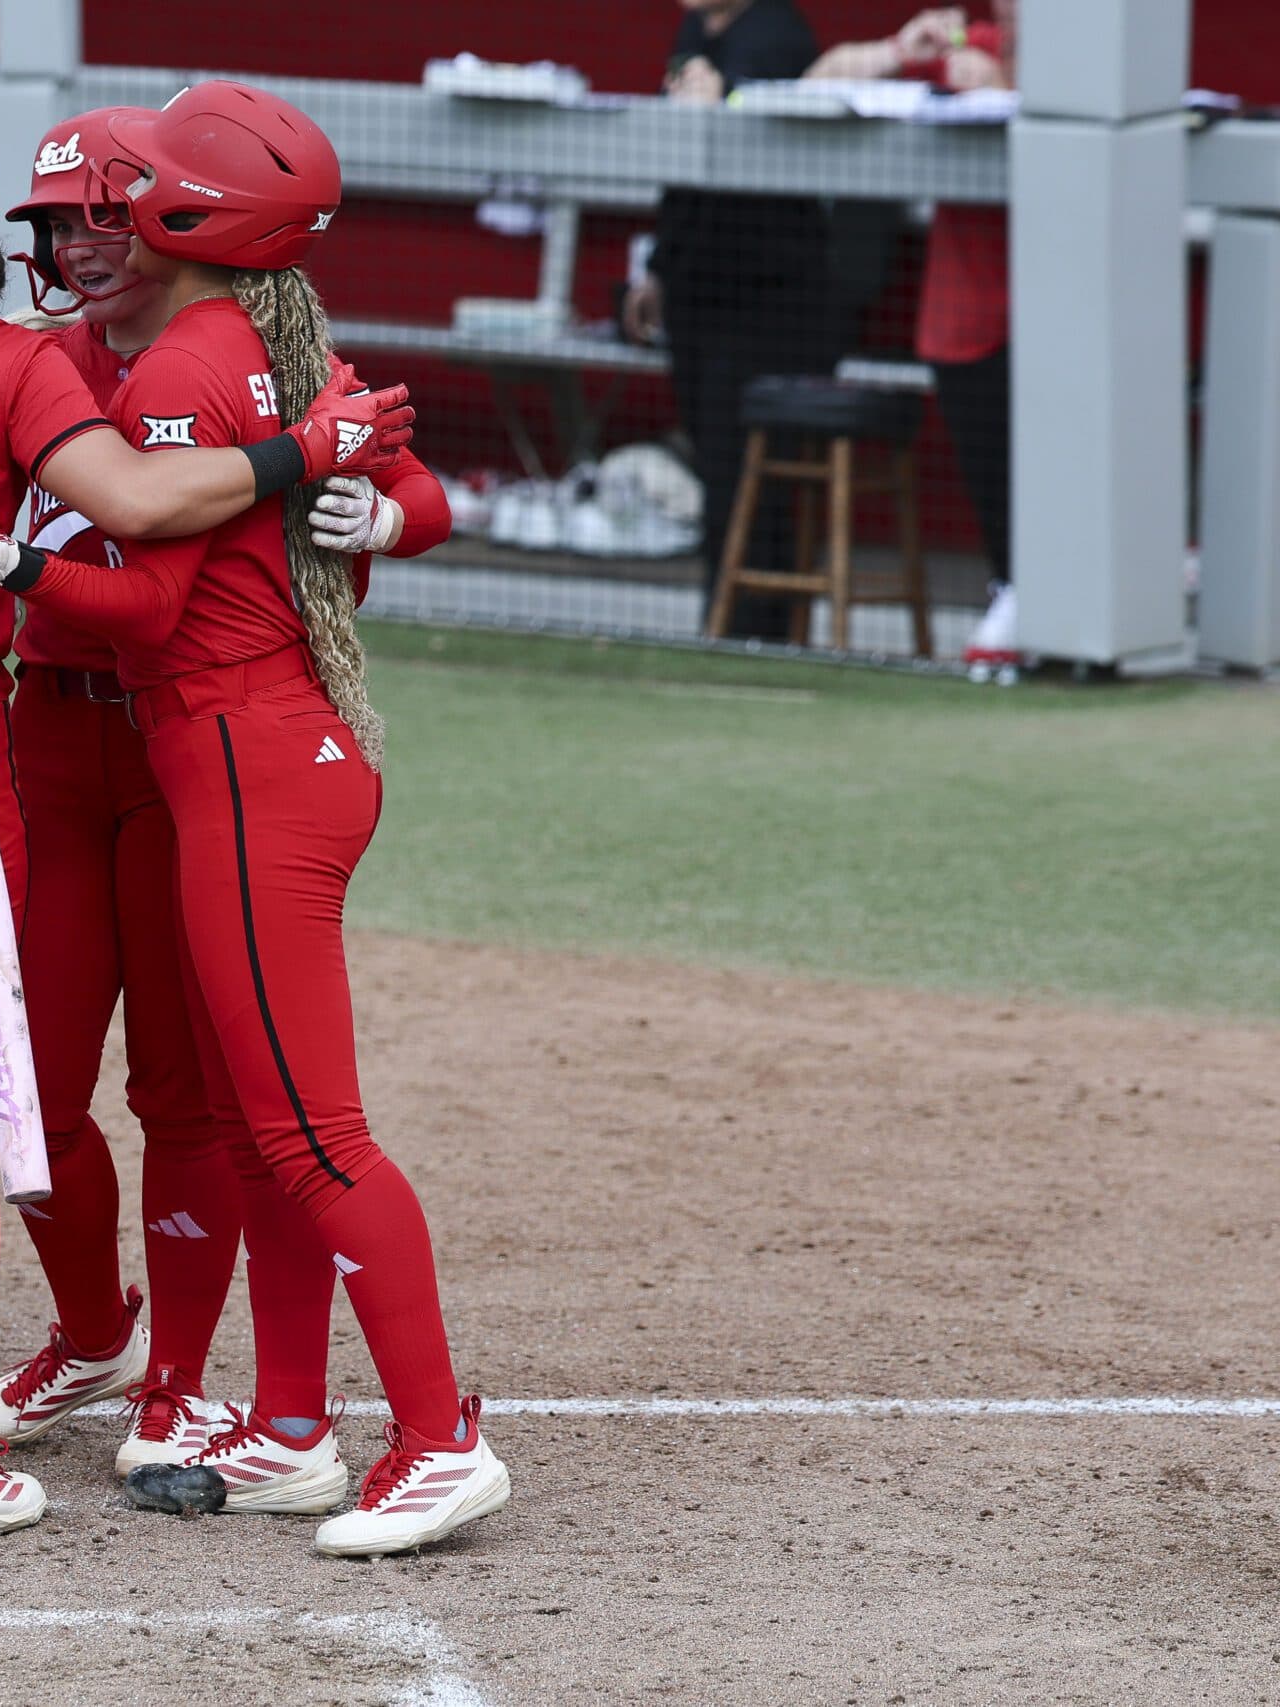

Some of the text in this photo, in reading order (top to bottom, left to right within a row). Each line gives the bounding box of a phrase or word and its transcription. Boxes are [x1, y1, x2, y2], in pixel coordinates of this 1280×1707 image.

[35, 132, 84, 176] Tech
[179, 180, 224, 199] EASTON
[141, 414, 197, 447] XII
[336, 424, 374, 463] adidas
